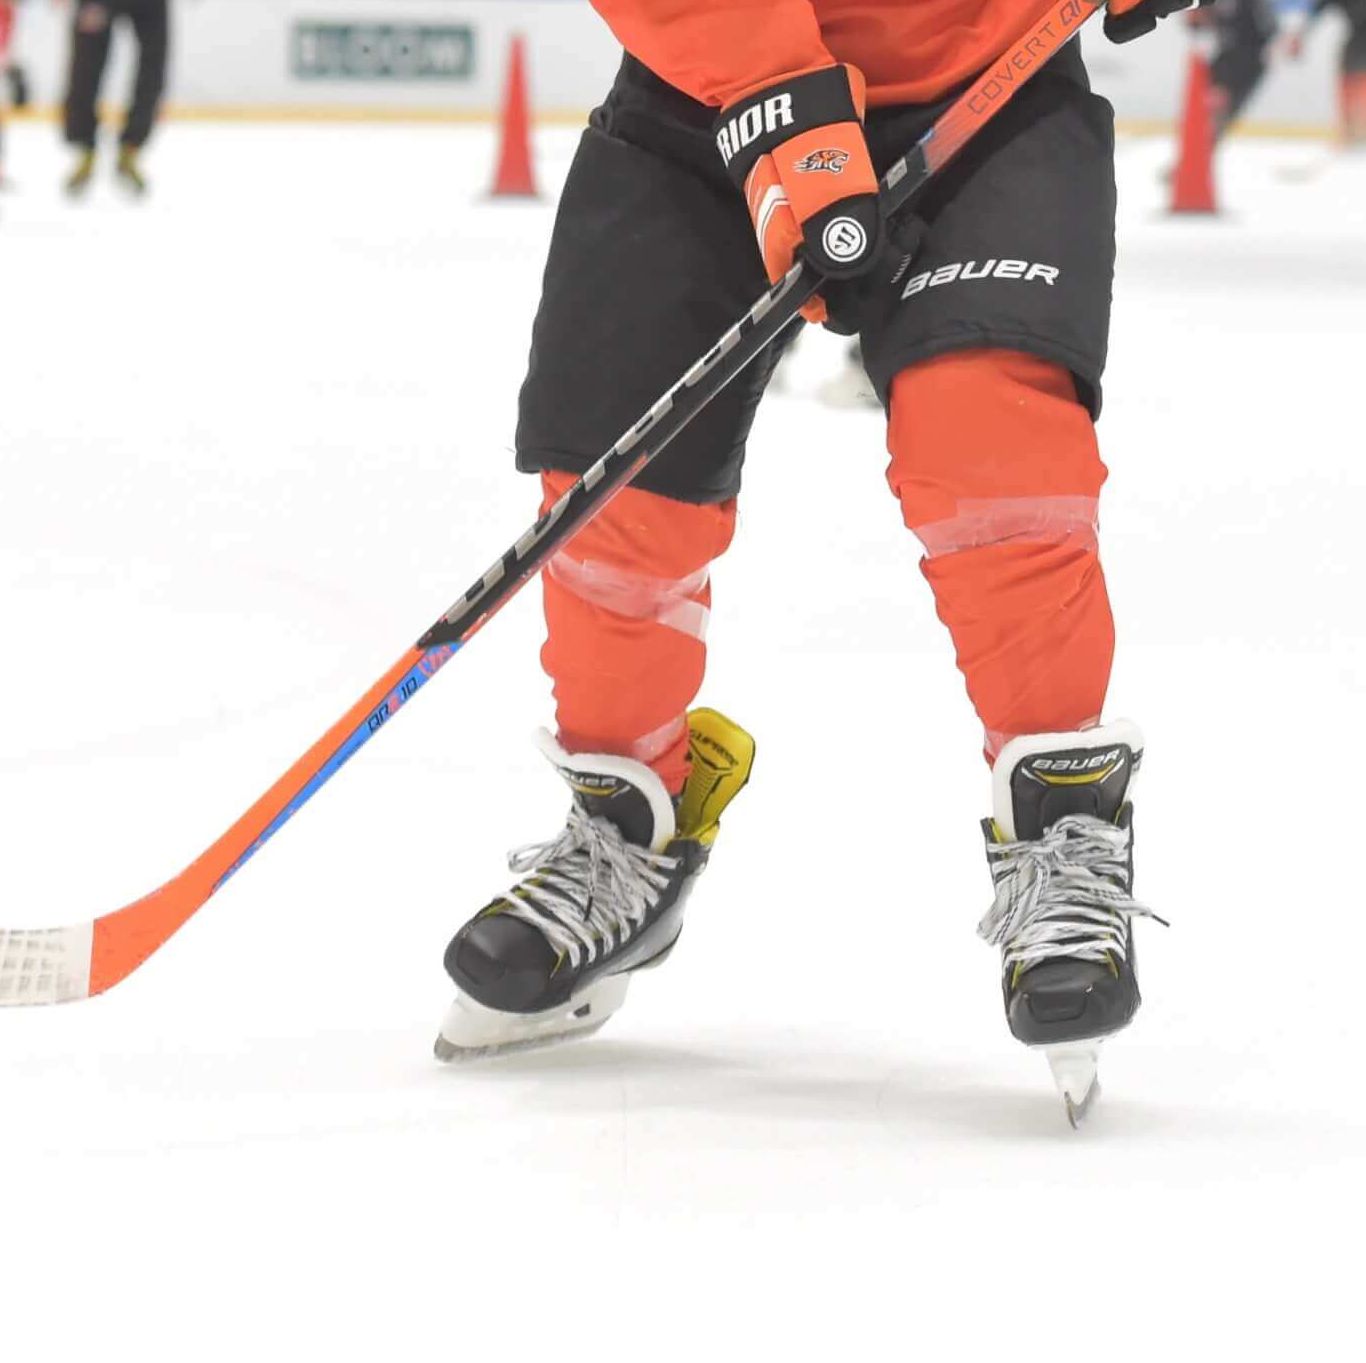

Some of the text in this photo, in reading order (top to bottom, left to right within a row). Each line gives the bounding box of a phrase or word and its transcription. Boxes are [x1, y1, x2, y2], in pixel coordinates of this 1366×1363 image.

[967, 21, 1057, 114] COVERT
[716, 92, 795, 169] RIOR
[900, 259, 1060, 300] BAUER
[1031, 748, 1121, 771] BAUER
